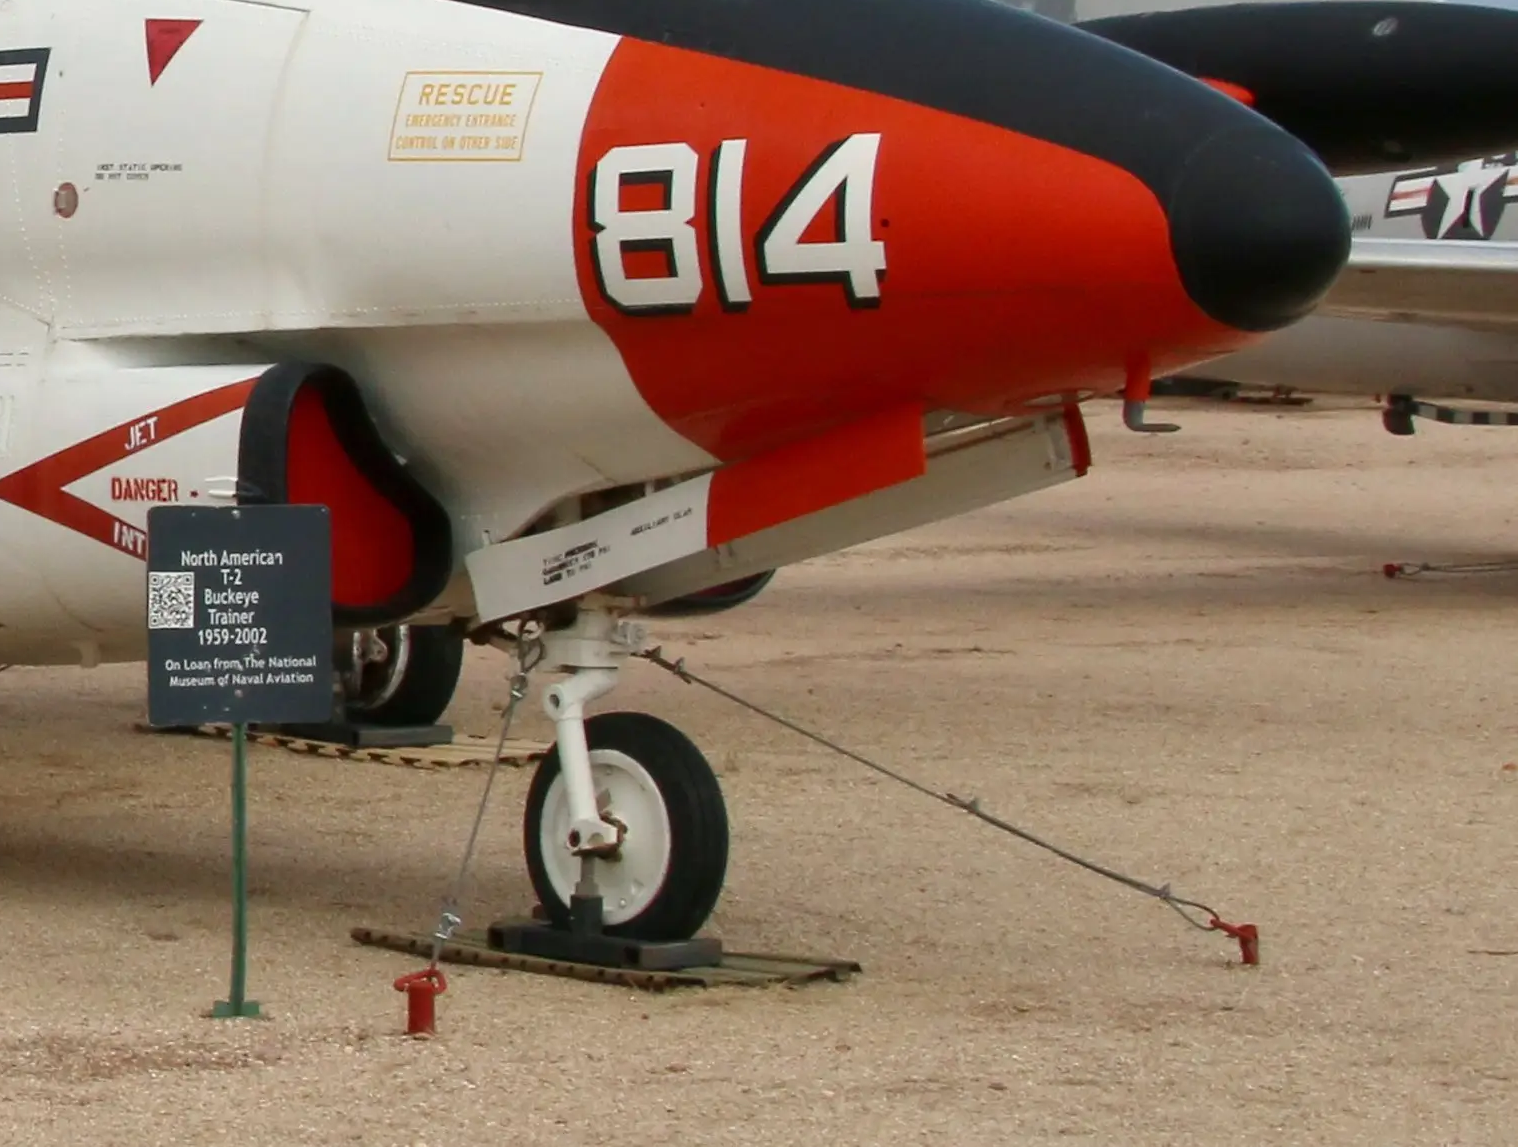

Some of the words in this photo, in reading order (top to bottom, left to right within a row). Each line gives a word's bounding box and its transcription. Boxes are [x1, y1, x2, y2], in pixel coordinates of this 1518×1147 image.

[418, 83, 517, 105] RESCUE
[405, 114, 462, 127] EMERGENCY
[465, 114, 516, 127] ENTRANCE
[395, 136, 437, 150] CONTROL
[459, 136, 492, 150] OTHER
[587, 132, 887, 316] 814
[124, 416, 158, 450] JET
[111, 476, 179, 502] DANGER
[181, 550, 217, 567] North
[220, 549, 283, 566] American
[220, 568, 242, 585] T-2
[204, 588, 259, 608] Buckeye
[207, 609, 255, 625] Trainer
[198, 627, 267, 645] 1959-2002
[165, 659, 180, 671] On
[184, 659, 211, 671] Loan
[214, 657, 242, 671] from
[244, 656, 265, 669] The
[268, 655, 317, 668] National
[169, 675, 214, 687] Museum
[217, 674, 229, 687] of
[232, 673, 263, 685] Naval
[266, 672, 314, 684] Aviation
